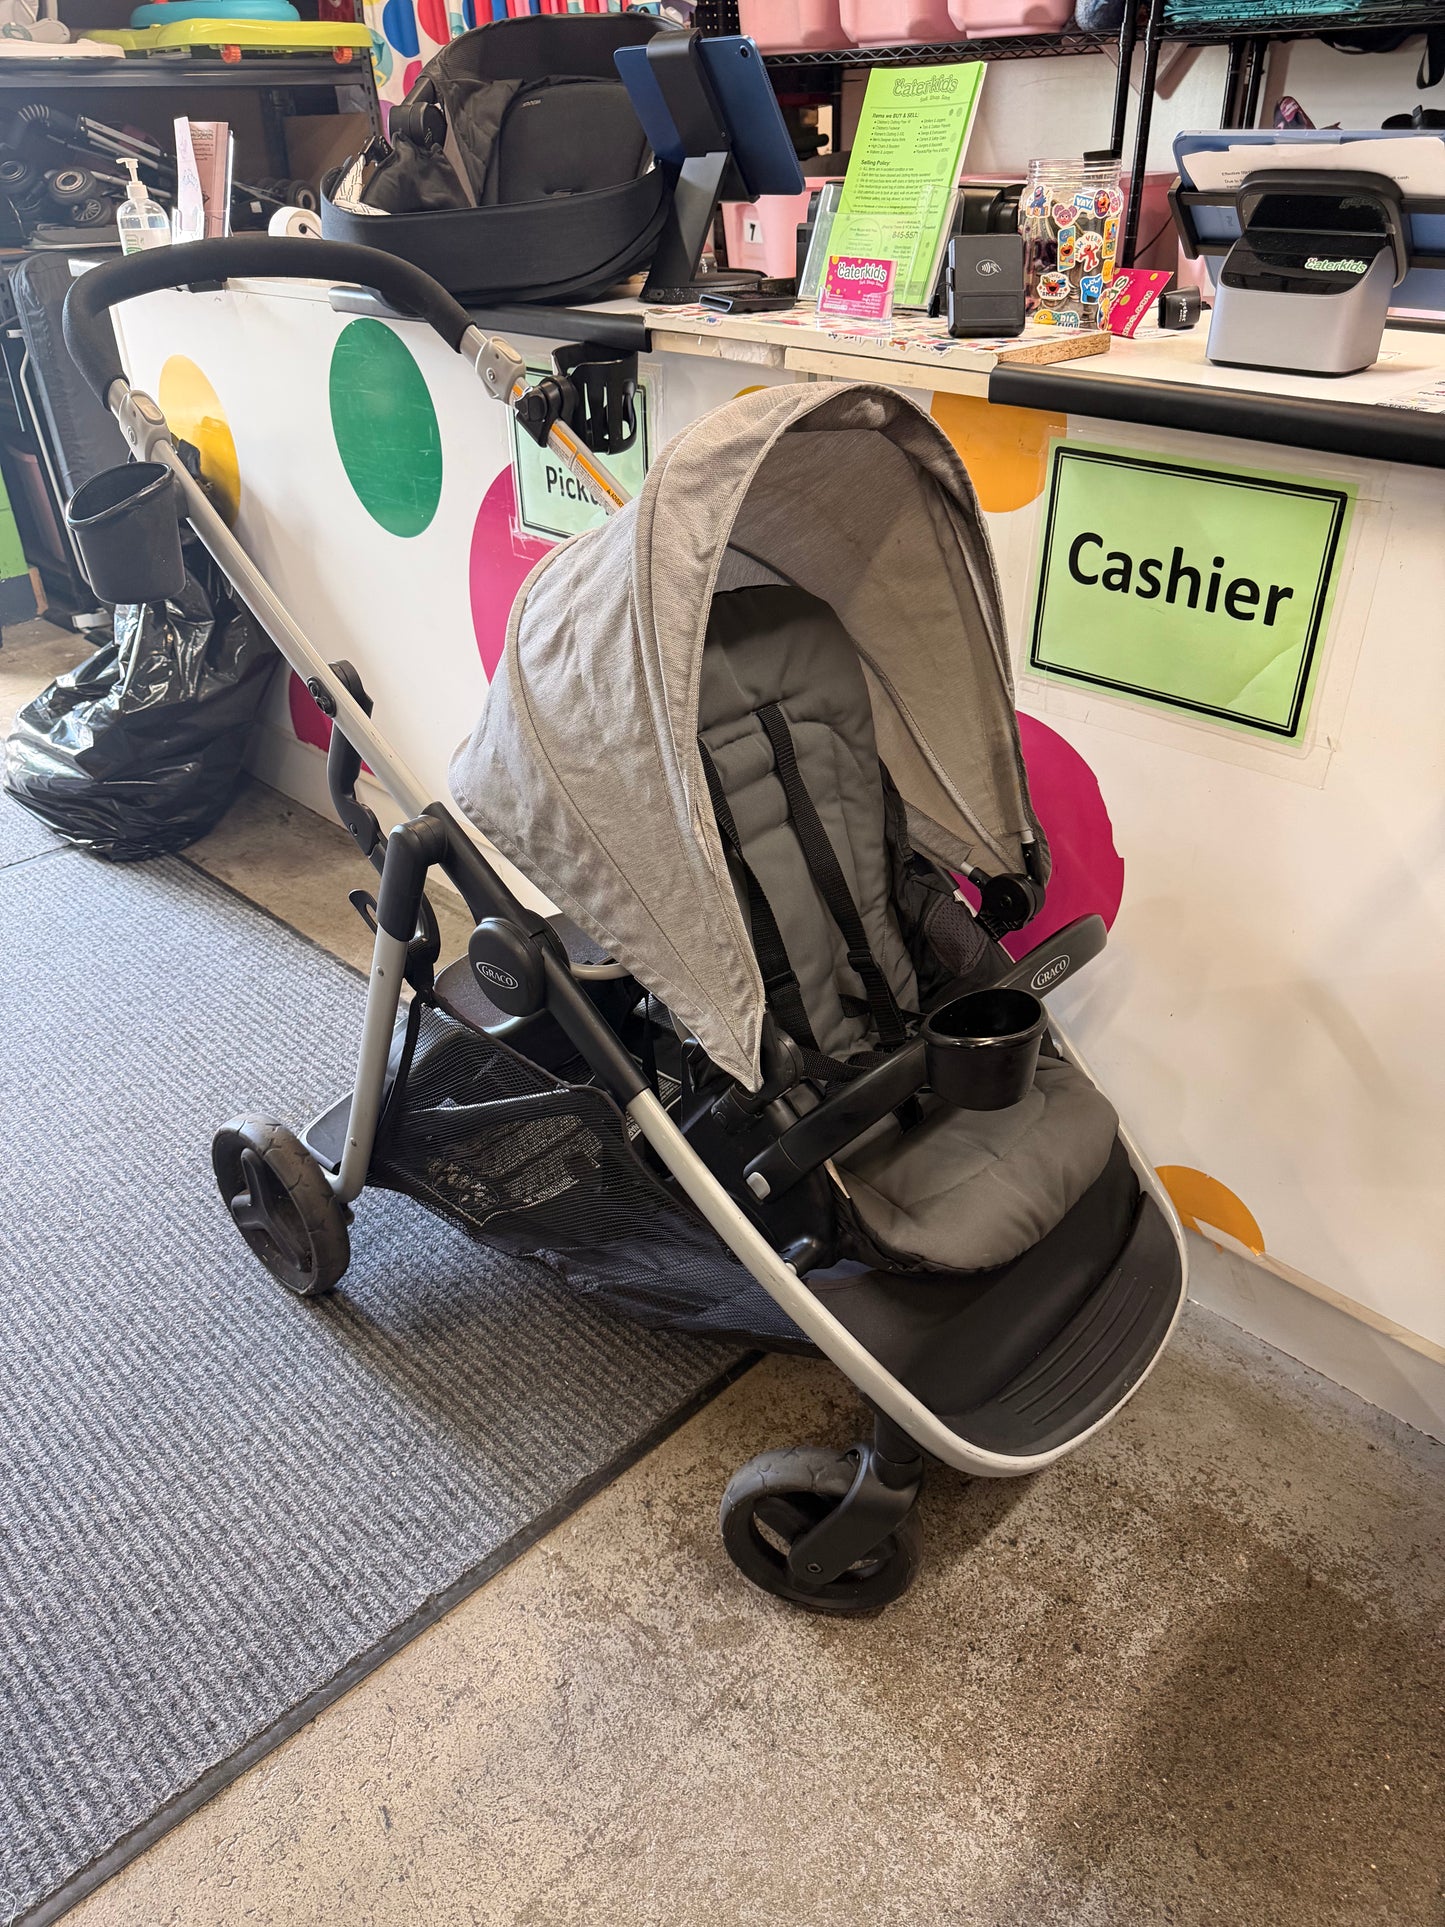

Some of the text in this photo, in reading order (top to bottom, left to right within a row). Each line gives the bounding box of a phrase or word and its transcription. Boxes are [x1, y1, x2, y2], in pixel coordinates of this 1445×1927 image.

[838, 262, 887, 282] Caterkids
[1305, 257, 1367, 274] Caterkids
[1068, 532, 1294, 627] Cashier
[481, 965, 513, 986] GRACO
[1036, 959, 1067, 986] GRACO
